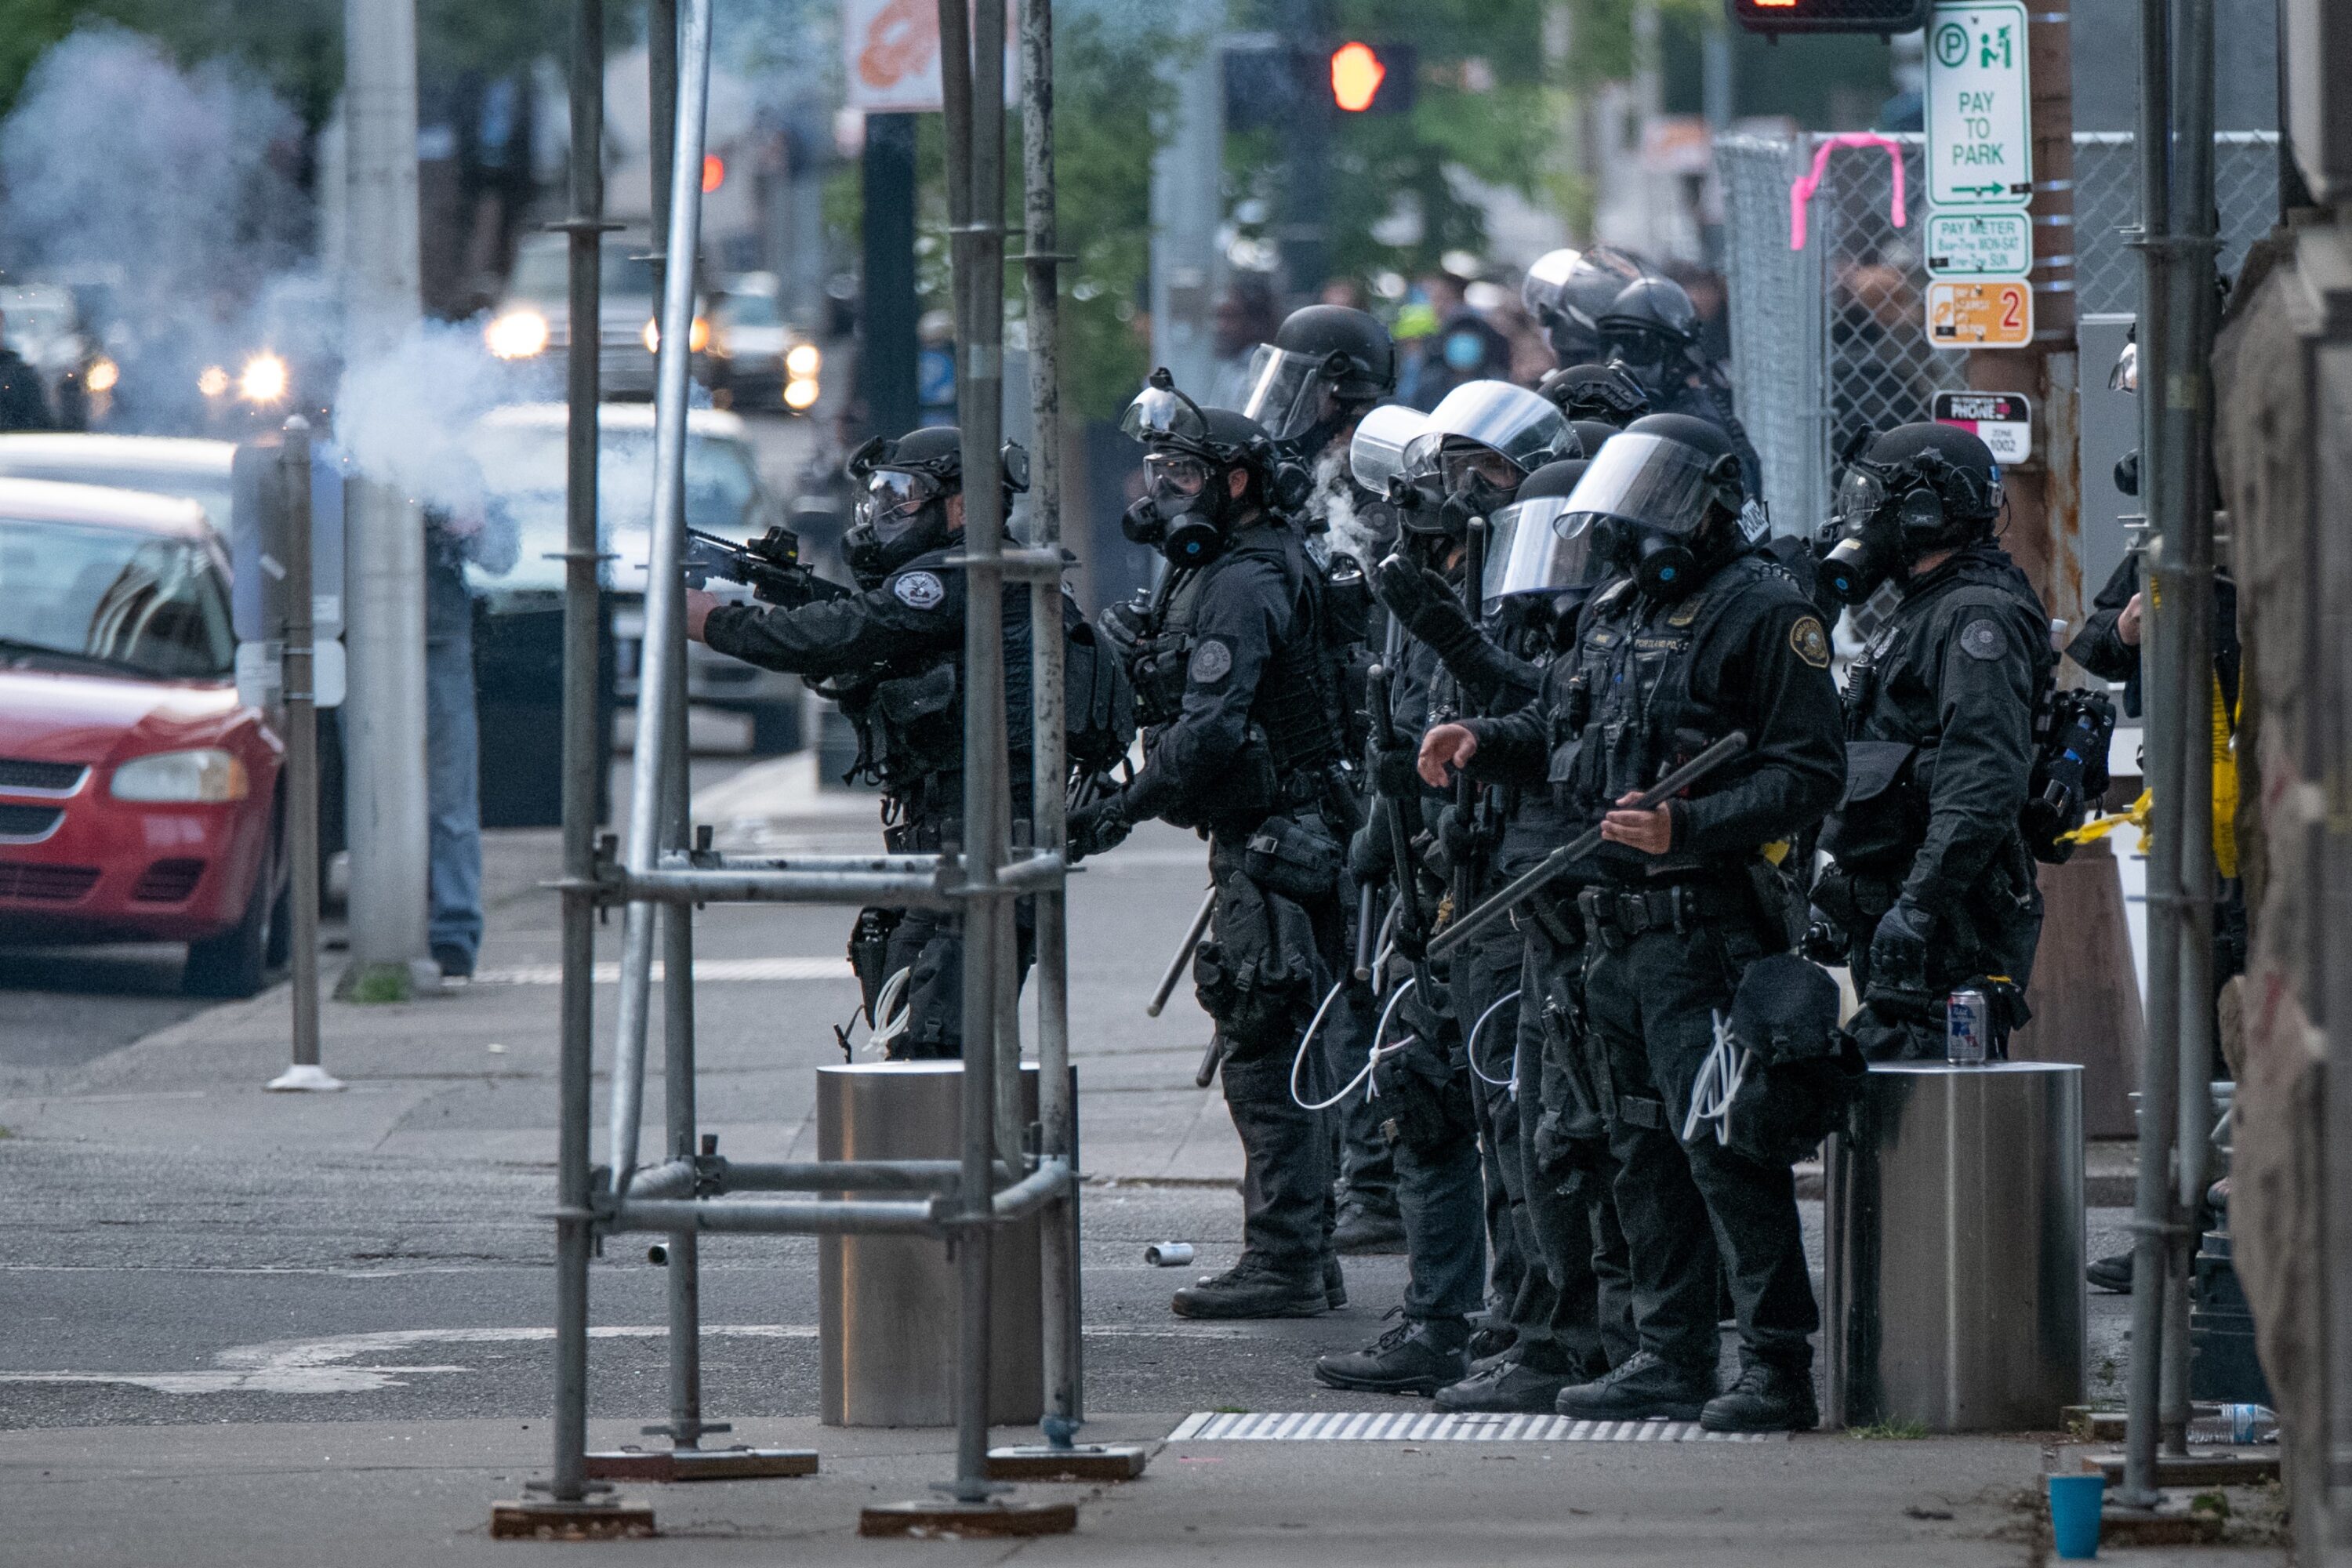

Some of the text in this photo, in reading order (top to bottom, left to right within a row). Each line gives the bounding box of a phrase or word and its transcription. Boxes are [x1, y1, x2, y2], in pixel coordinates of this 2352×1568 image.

[1946, 33, 1961, 59] P
[1958, 91, 1994, 113] PAY
[1964, 117, 1990, 139] TO
[1952, 143, 2004, 165] PARK
[1941, 220, 2015, 234] PAY METER
[2002, 289, 2020, 328] 2
